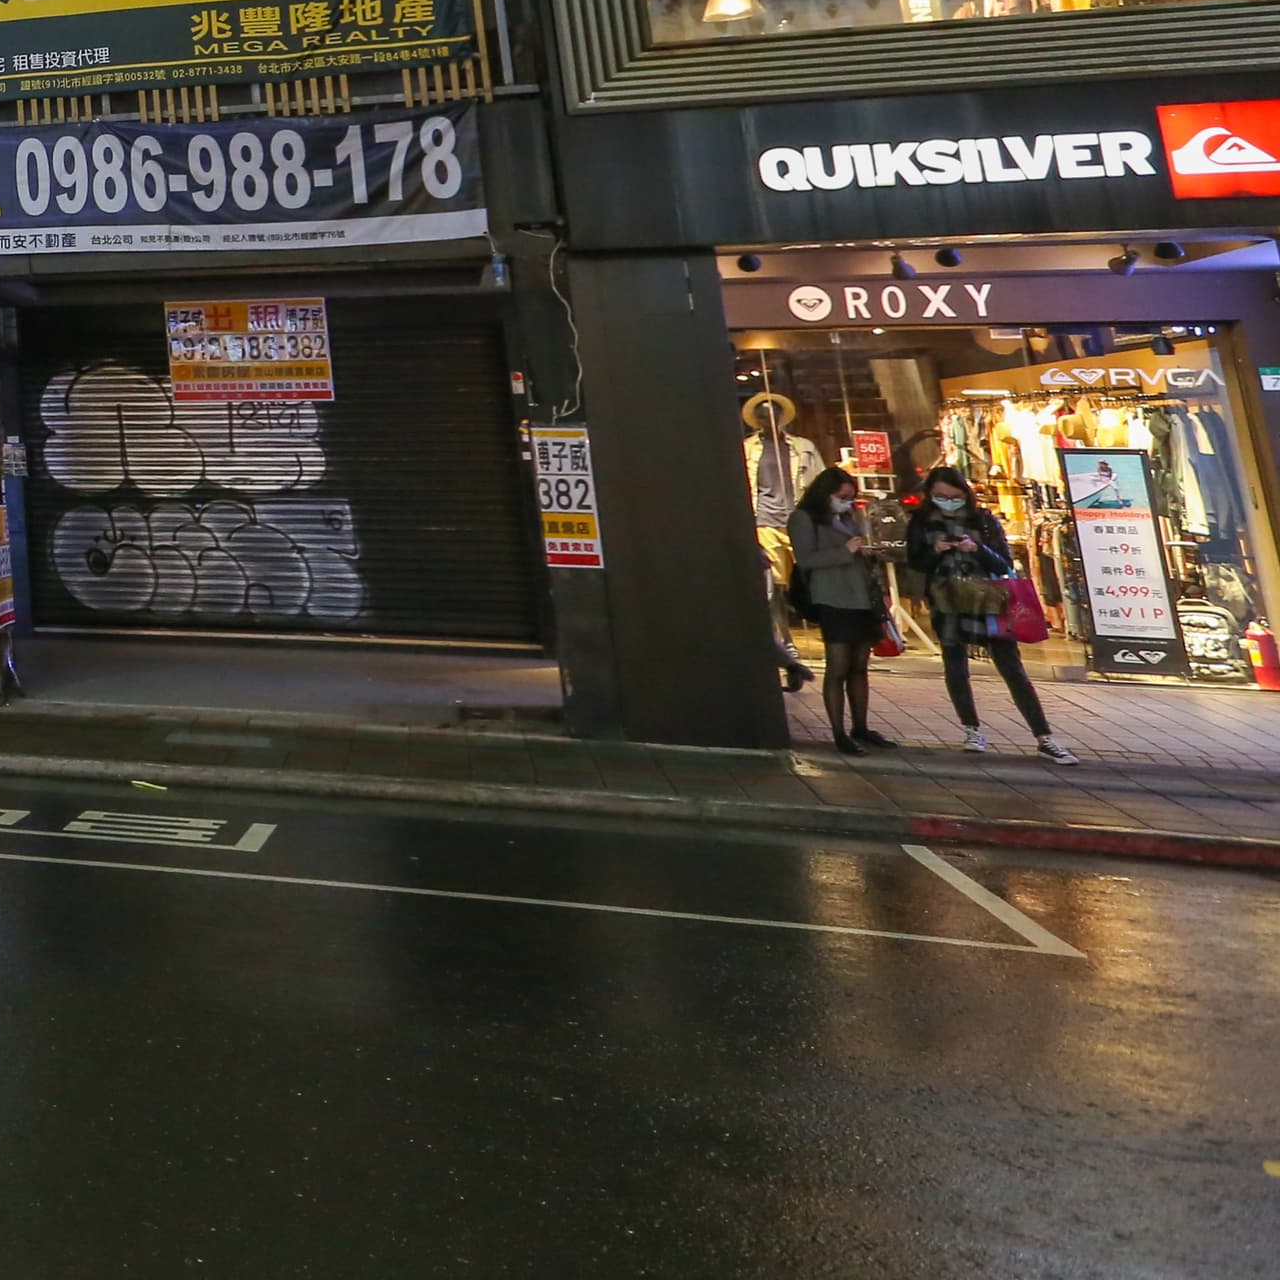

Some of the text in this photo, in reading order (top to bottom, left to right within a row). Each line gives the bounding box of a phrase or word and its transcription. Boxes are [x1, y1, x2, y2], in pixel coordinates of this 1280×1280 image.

[194, 25, 434, 55] MEGA REALTY
[13, 47, 110, 70] 租售投資代理
[16, 117, 462, 216] 0986-988-178
[759, 130, 1156, 192] QUIKSILVER
[844, 283, 993, 319] ROXY
[1109, 366, 1225, 388] RVCA
[538, 478, 593, 511] 382
